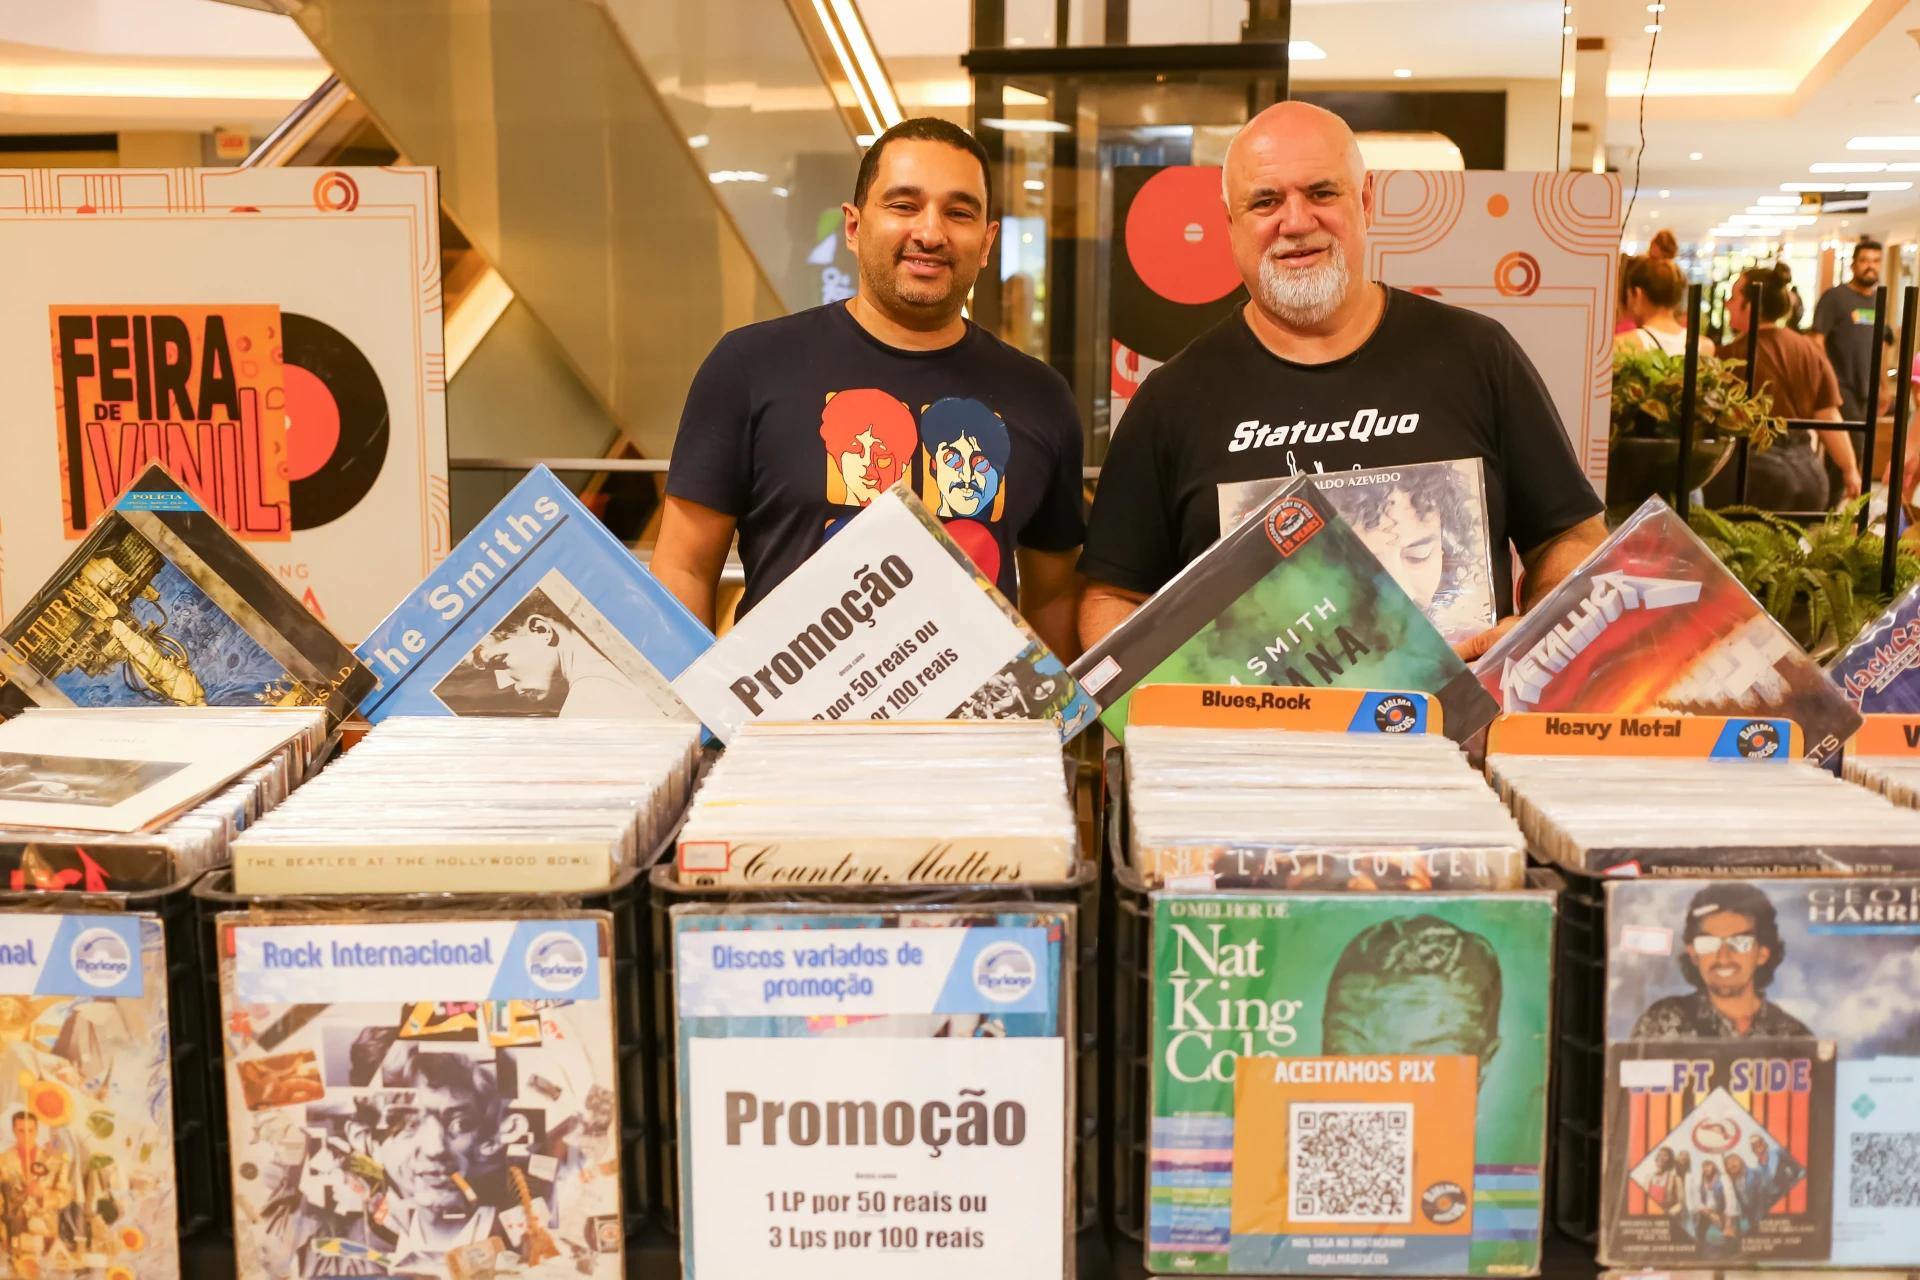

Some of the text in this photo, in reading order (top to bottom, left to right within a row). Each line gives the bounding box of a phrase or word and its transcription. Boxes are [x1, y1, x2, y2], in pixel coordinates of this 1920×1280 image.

[58, 315, 241, 530] FEIRA
[94, 403, 121, 421] DE
[1348, 472, 1401, 487] AZEVEDO
[428, 495, 560, 621] Smiths
[729, 554, 914, 717] Promoção
[1247, 597, 1337, 676] SMITH
[1500, 569, 1702, 712] METALLICA
[849, 670, 879, 697] 50
[875, 639, 918, 678] reais
[915, 620, 939, 643] ou
[868, 648, 959, 720] or 100 reais
[1545, 717, 1681, 740] Heavy Metal
[248, 857, 592, 867] THE BEATLES AT THE HOLLYWOOD BOWL
[905, 843, 1022, 883] Matters
[1236, 850, 1327, 877] LAST
[1347, 850, 1514, 877] CONCERT
[1808, 905, 1920, 922] HARRI
[0, 939, 36, 966] nal
[263, 938, 494, 968] Rock Internacional
[713, 943, 923, 970] Discos variados de
[1169, 924, 1265, 979] Nat
[763, 974, 874, 1003] promoção
[1167, 977, 1303, 1047] King
[1275, 1060, 1436, 1084] ACEITAMOS PIX
[1732, 1058, 1811, 1094] SIDE
[725, 1088, 1027, 1158] Promoção
[766, 1191, 987, 1214] 1 LP por 50 reais ou
[769, 1226, 985, 1250] 3 Lps por 100 reais
